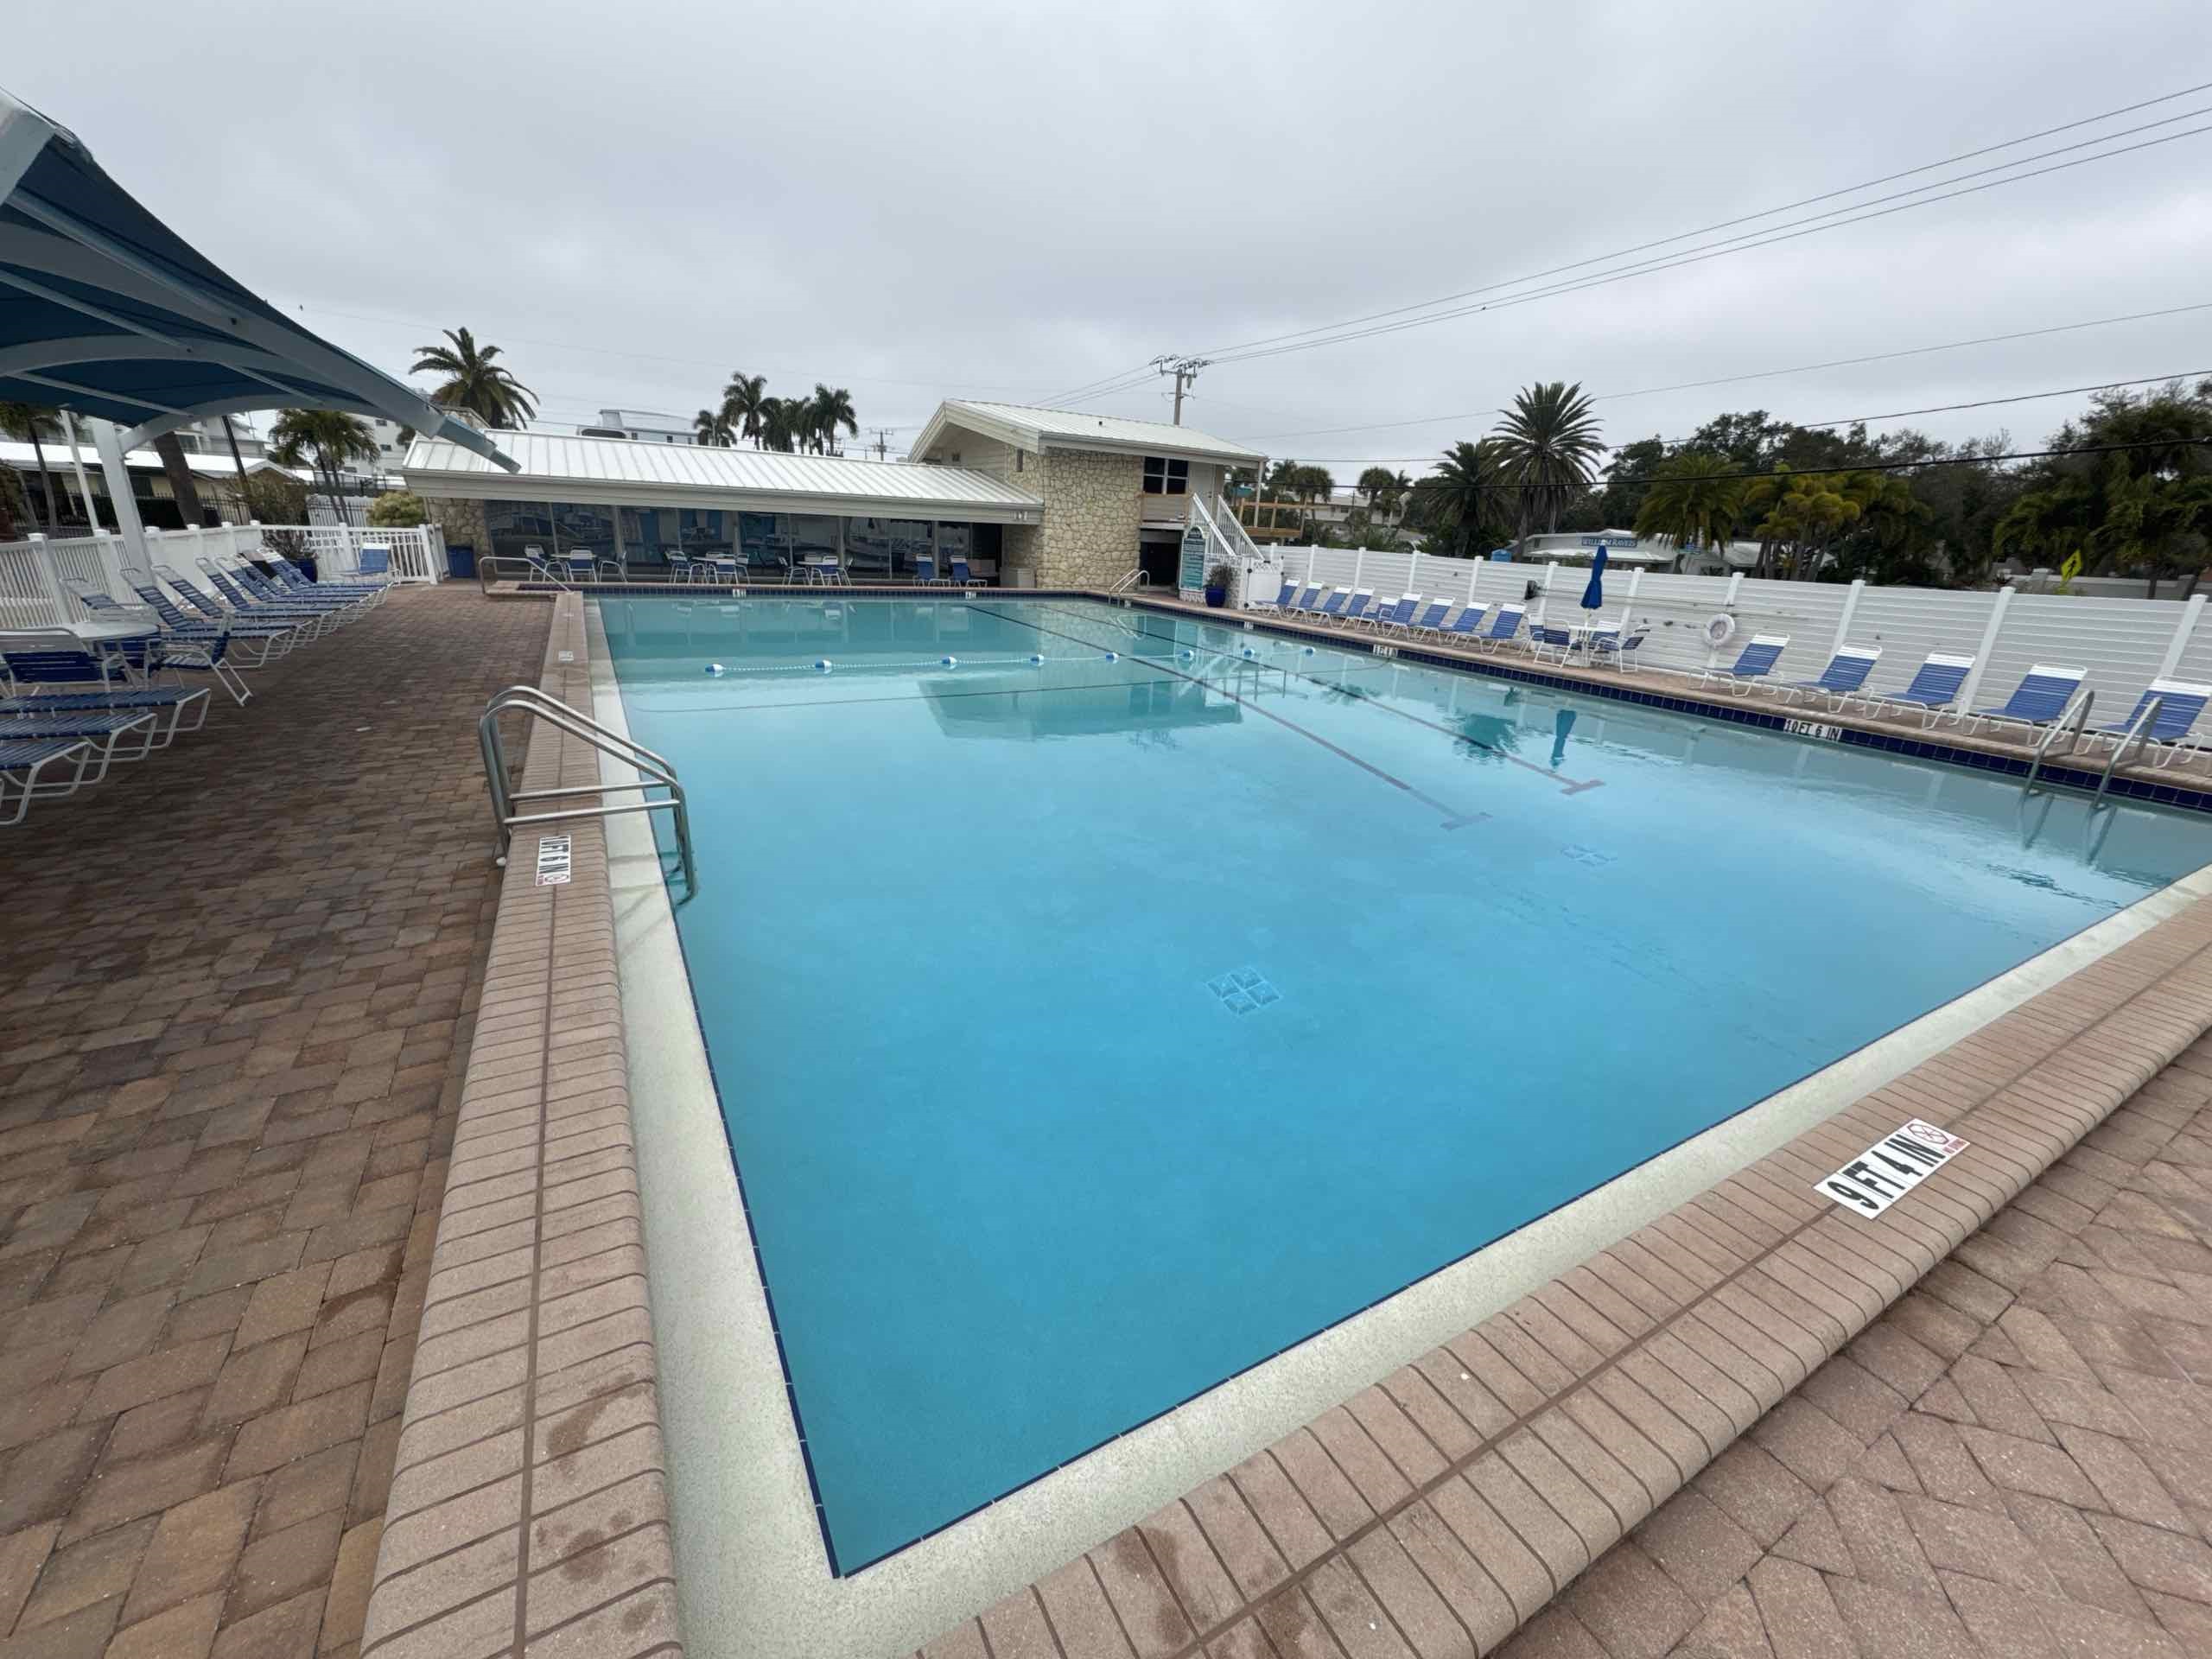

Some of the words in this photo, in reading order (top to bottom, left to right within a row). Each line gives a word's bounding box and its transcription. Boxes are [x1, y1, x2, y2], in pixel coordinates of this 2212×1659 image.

[1826, 726, 1840, 741] IN
[538, 862, 569, 874] IN
[1884, 1133, 1946, 1167] IN
[1871, 1149, 1924, 1177] 4
